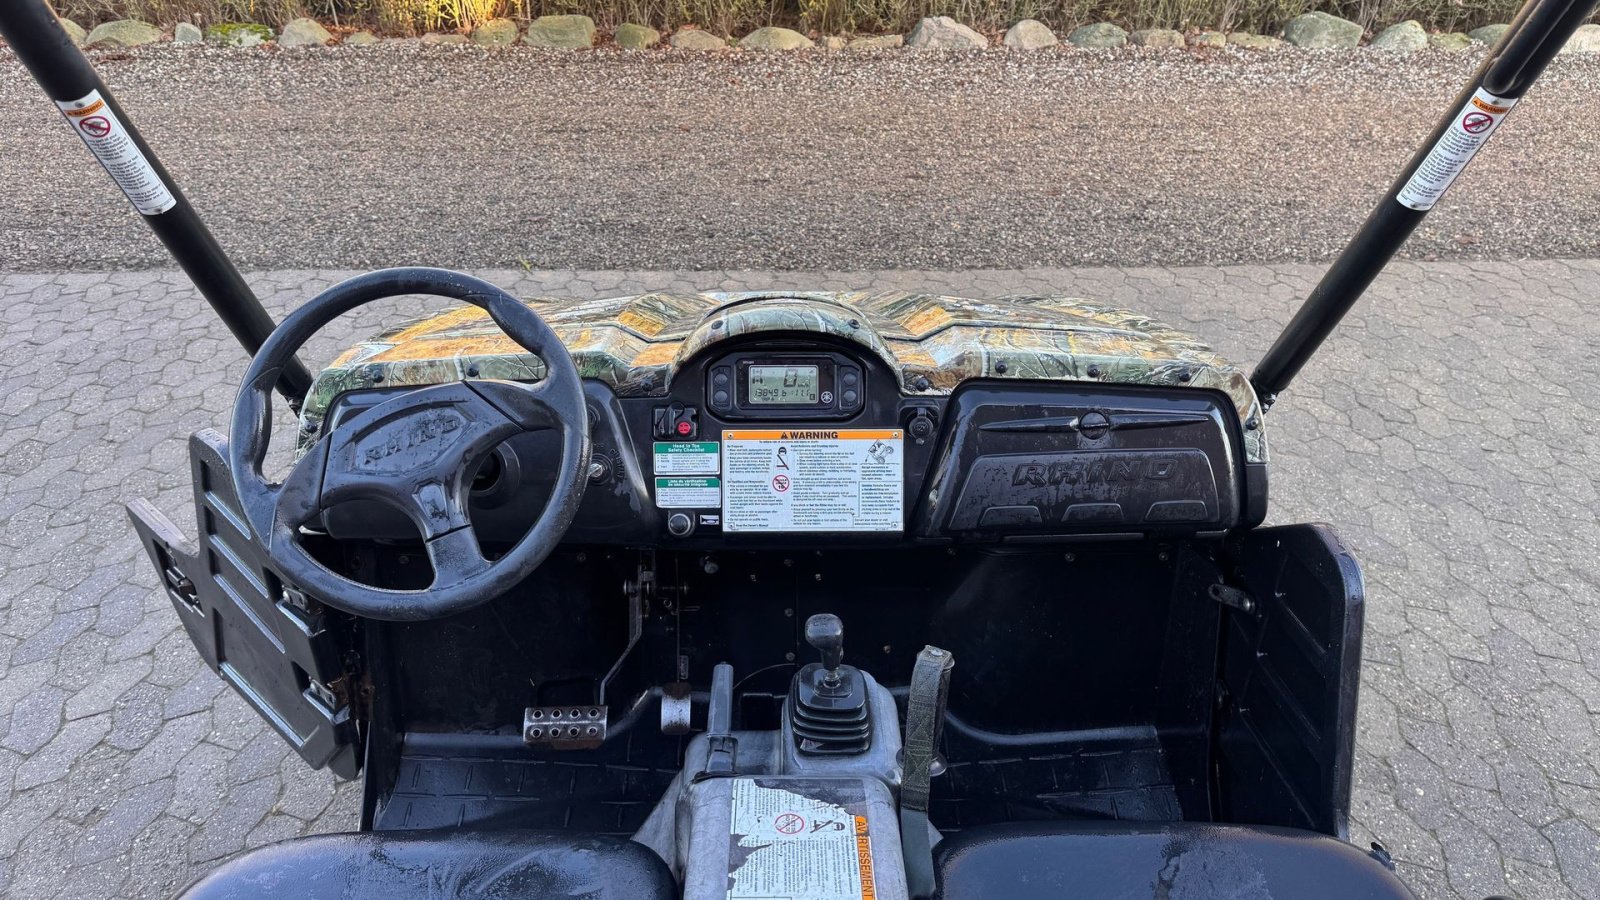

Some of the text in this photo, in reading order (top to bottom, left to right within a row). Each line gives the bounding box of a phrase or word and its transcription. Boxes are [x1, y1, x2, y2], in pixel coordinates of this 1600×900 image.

[74, 102, 102, 115] WARNING
[784, 369, 798, 387] 0
[1012, 459, 1178, 487] RHINO
